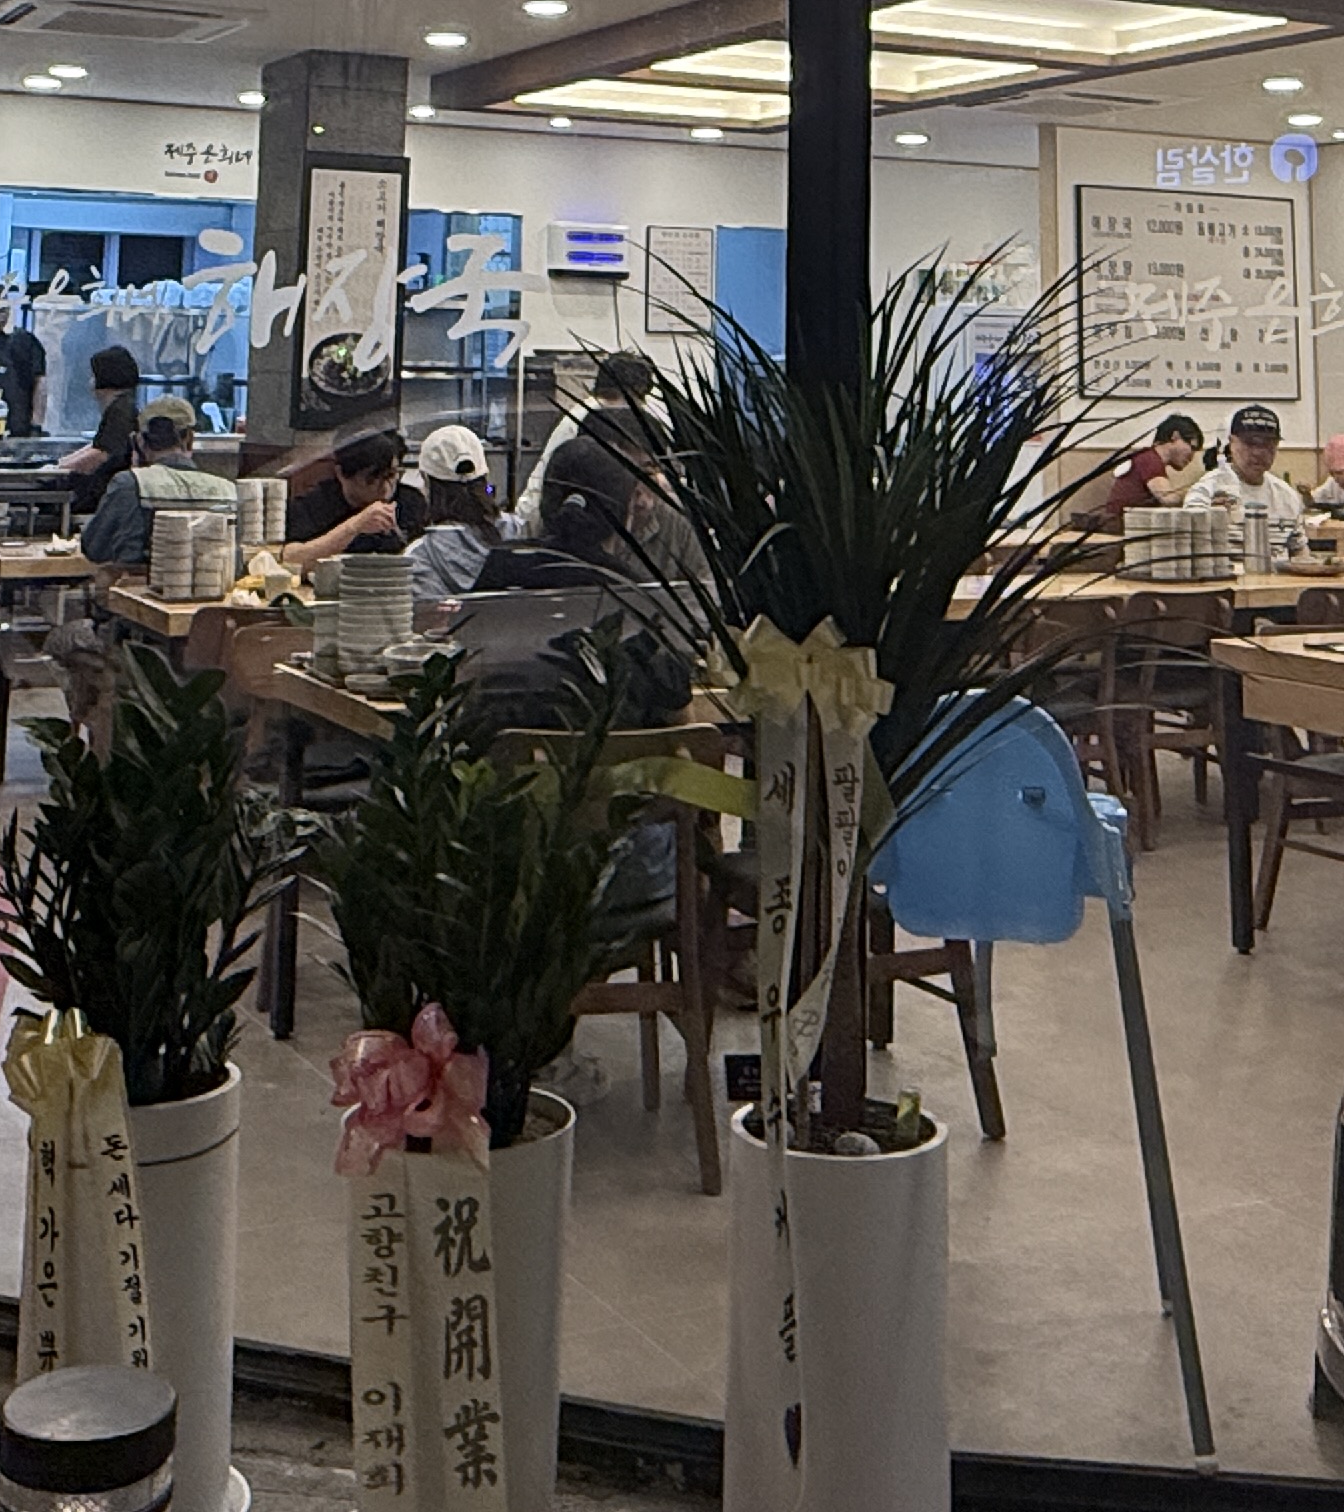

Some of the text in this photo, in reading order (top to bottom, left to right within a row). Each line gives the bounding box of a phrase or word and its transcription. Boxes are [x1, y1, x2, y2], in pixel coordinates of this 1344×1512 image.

[360, 1192, 409, 1336] 고향친구
[433, 1196, 501, 1490] 祝開業
